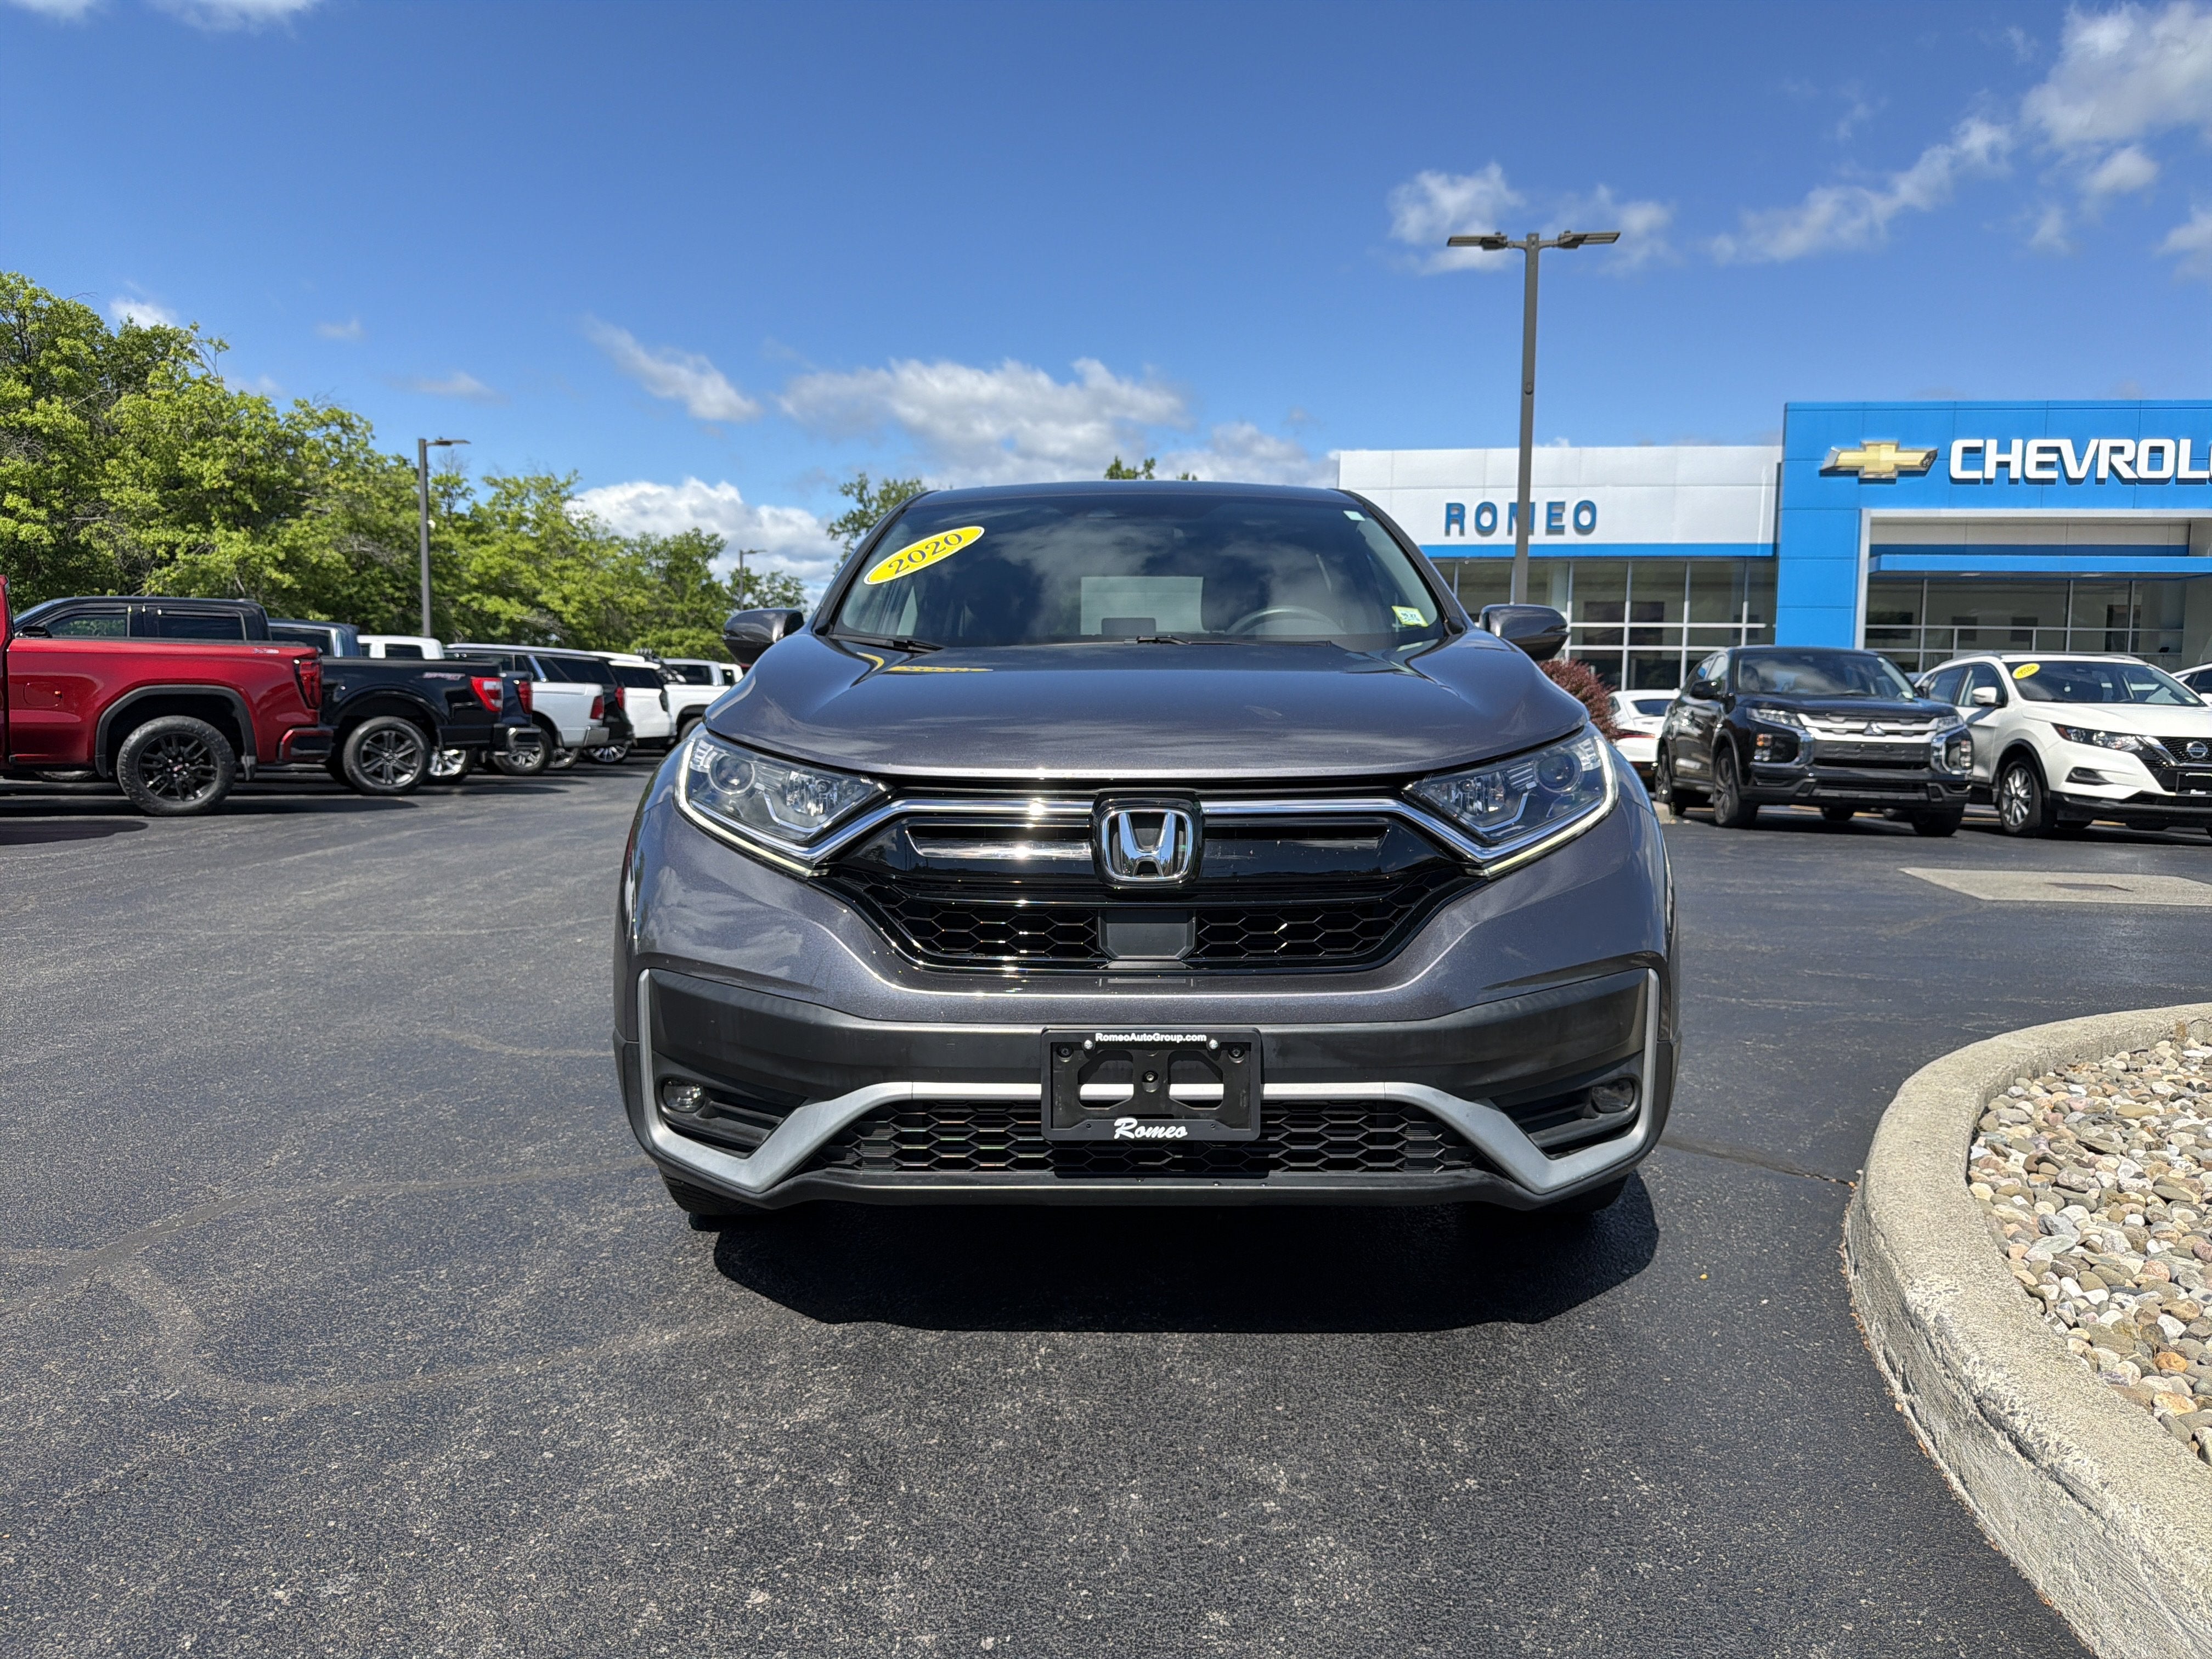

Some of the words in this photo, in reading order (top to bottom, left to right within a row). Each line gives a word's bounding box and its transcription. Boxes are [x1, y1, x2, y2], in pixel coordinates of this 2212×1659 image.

[1949, 438, 2212, 479] CHEVROL
[1444, 500, 1597, 535] ROMEO
[888, 533, 963, 575] 2020
[1095, 1032, 1207, 1043] RomeoAutoGroup.com
[1114, 1118, 1188, 1139] Romeo
